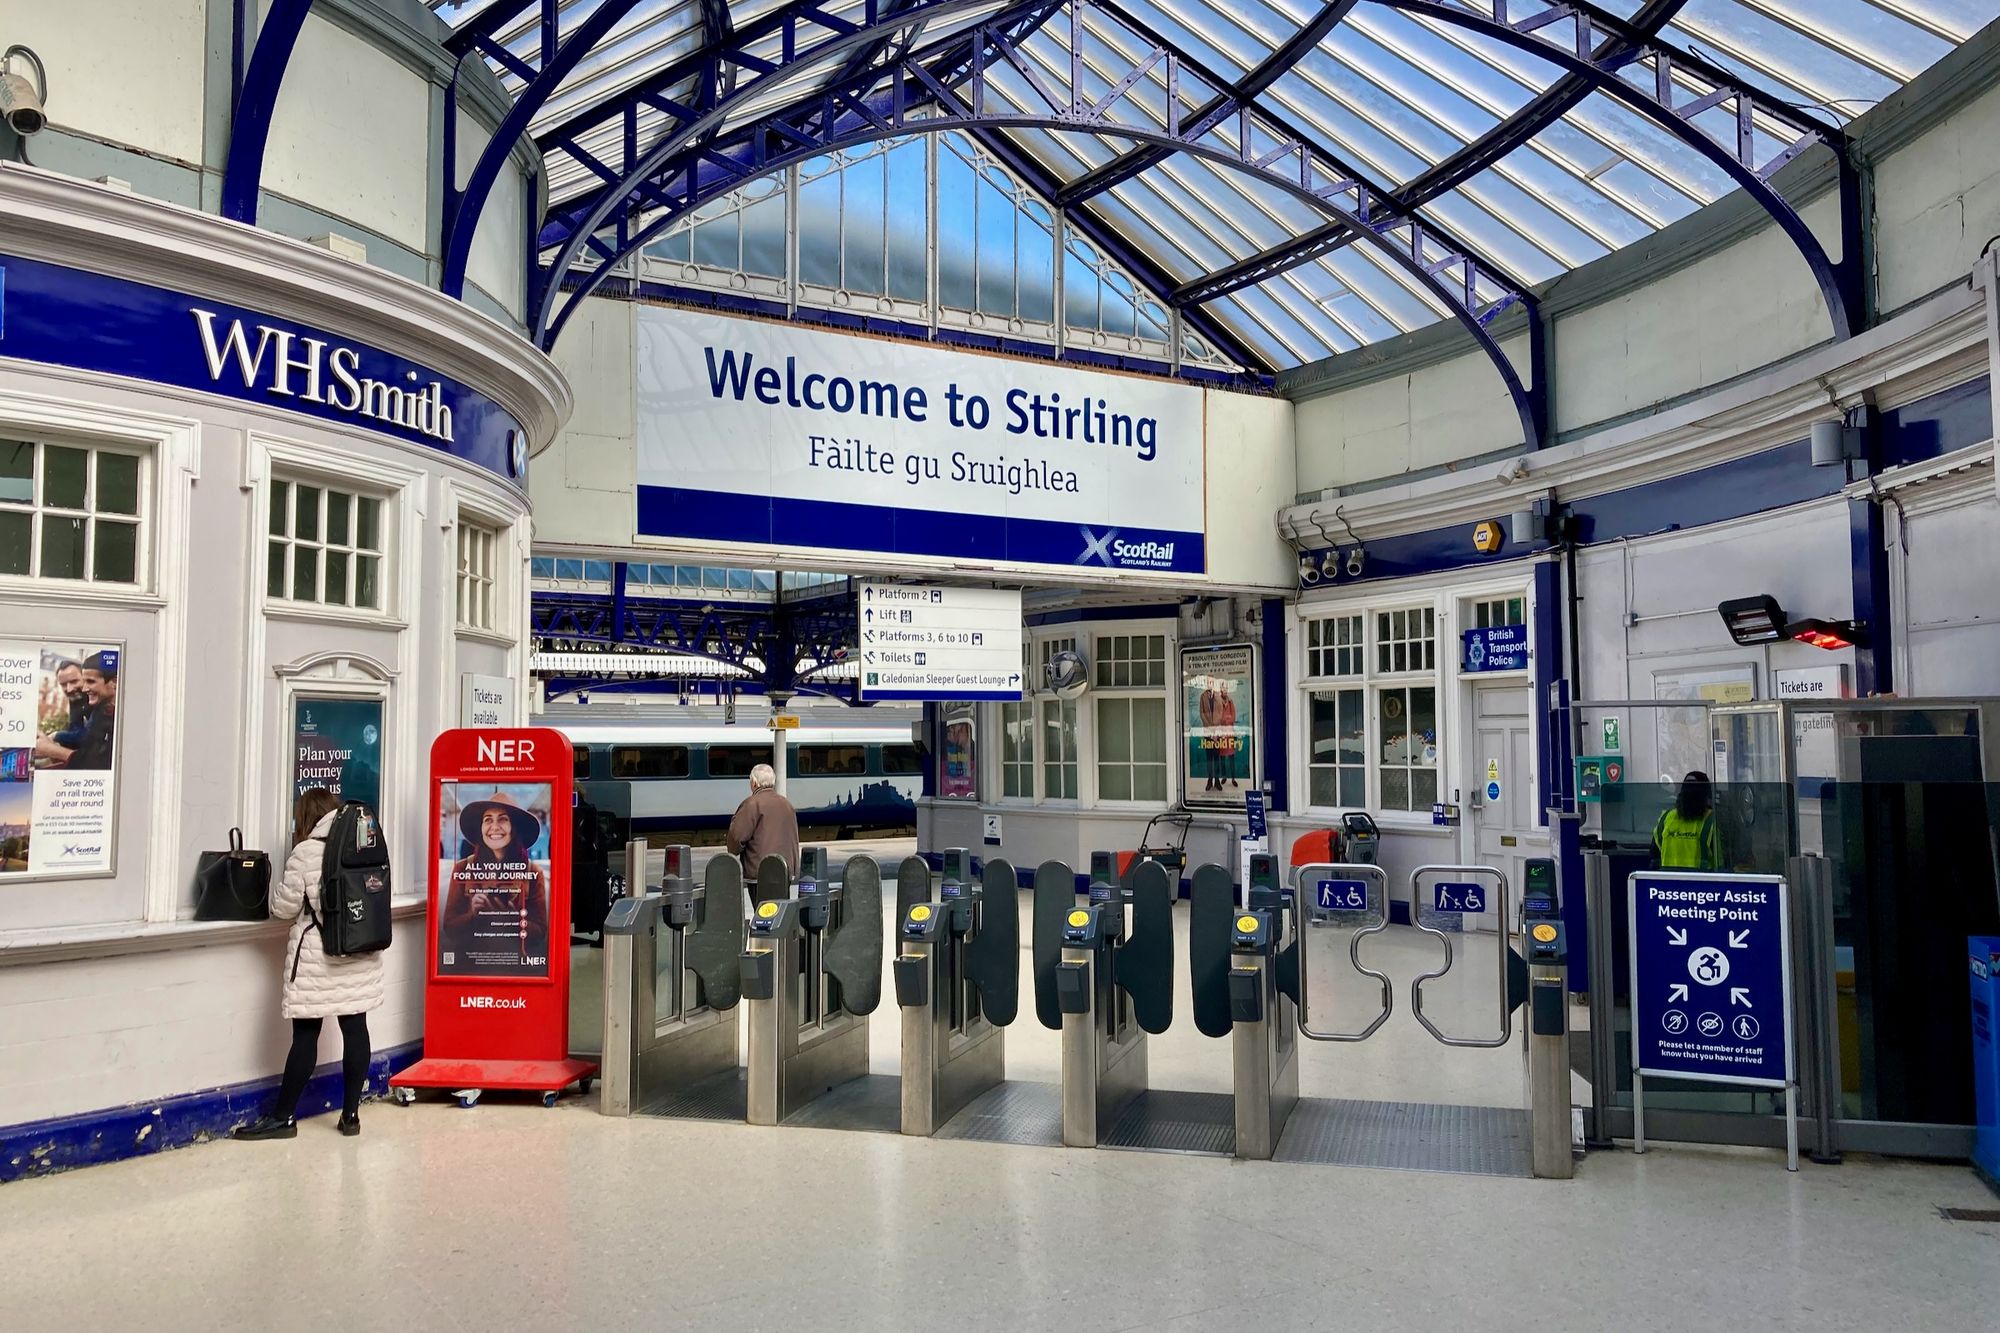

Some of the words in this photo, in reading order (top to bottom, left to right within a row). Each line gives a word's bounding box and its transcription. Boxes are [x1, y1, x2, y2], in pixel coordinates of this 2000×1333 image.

[189, 308, 455, 443] WHSmith
[703, 346, 928, 423] Welcome
[945, 383, 990, 429] to
[1006, 388, 1157, 461] Stirling
[808, 436, 894, 475] Fàilte
[905, 452, 940, 485] gu
[950, 451, 1079, 495] Sruighlea
[1113, 539, 1174, 560] ScotRail
[879, 588, 919, 600] Platform
[922, 591, 928, 601] 2
[879, 609, 897, 620] Lift
[879, 630, 924, 642] Platforms
[926, 633, 936, 644] 3,
[938, 634, 944, 642] 6
[946, 634, 956, 643] to
[958, 633, 969, 643] 10
[1488, 629, 1514, 641] British
[1488, 641, 1527, 654] Transport
[880, 652, 912, 663] Toilets
[1488, 655, 1513, 666] Police
[881, 673, 925, 685] Caledonian
[926, 674, 955, 686] Sleeper
[956, 674, 977, 685] Guest
[979, 674, 1006, 687] Lounge
[1780, 680, 1809, 694] Tickets
[1809, 681, 1823, 692] are
[474, 688, 493, 703] Tickets
[494, 693, 503, 704] are
[474, 709, 498, 725] available
[727, 705, 733, 719] 2
[7, 720, 25, 732] 50
[477, 735, 535, 766] NER
[1201, 738, 1229, 750] Harold
[1229, 738, 1244, 751] Fry
[299, 746, 326, 761] Plan
[328, 749, 352, 763] your
[297, 764, 342, 782] journey
[63, 779, 81, 787] Save
[329, 784, 341, 794] us
[68, 789, 80, 797] rail
[82, 789, 104, 797] travel
[61, 801, 78, 809] year
[465, 862, 482, 871] ALL
[483, 862, 501, 871] YOU
[503, 862, 526, 870] NEED
[453, 872, 471, 880] FOR
[473, 872, 496, 880] YOUR
[498, 871, 539, 880] JOURNEY
[1649, 887, 1721, 904] Passenger
[1724, 889, 1767, 903] Assist
[1658, 905, 1716, 922] Meeting
[1719, 907, 1759, 921] Point
[520, 956, 546, 966] LNER
[460, 996, 526, 1009] LNER.co.uk
[1658, 1040, 1683, 1049] Please
[1684, 1041, 1695, 1050] let
[1702, 1043, 1733, 1053] member
[1735, 1045, 1744, 1054] of
[1745, 1047, 1763, 1055] staff
[1661, 1049, 1682, 1057] know
[1683, 1050, 1699, 1059] that
[1700, 1053, 1714, 1061] you
[1714, 1053, 1733, 1062] have
[1734, 1054, 1763, 1064] arrived
